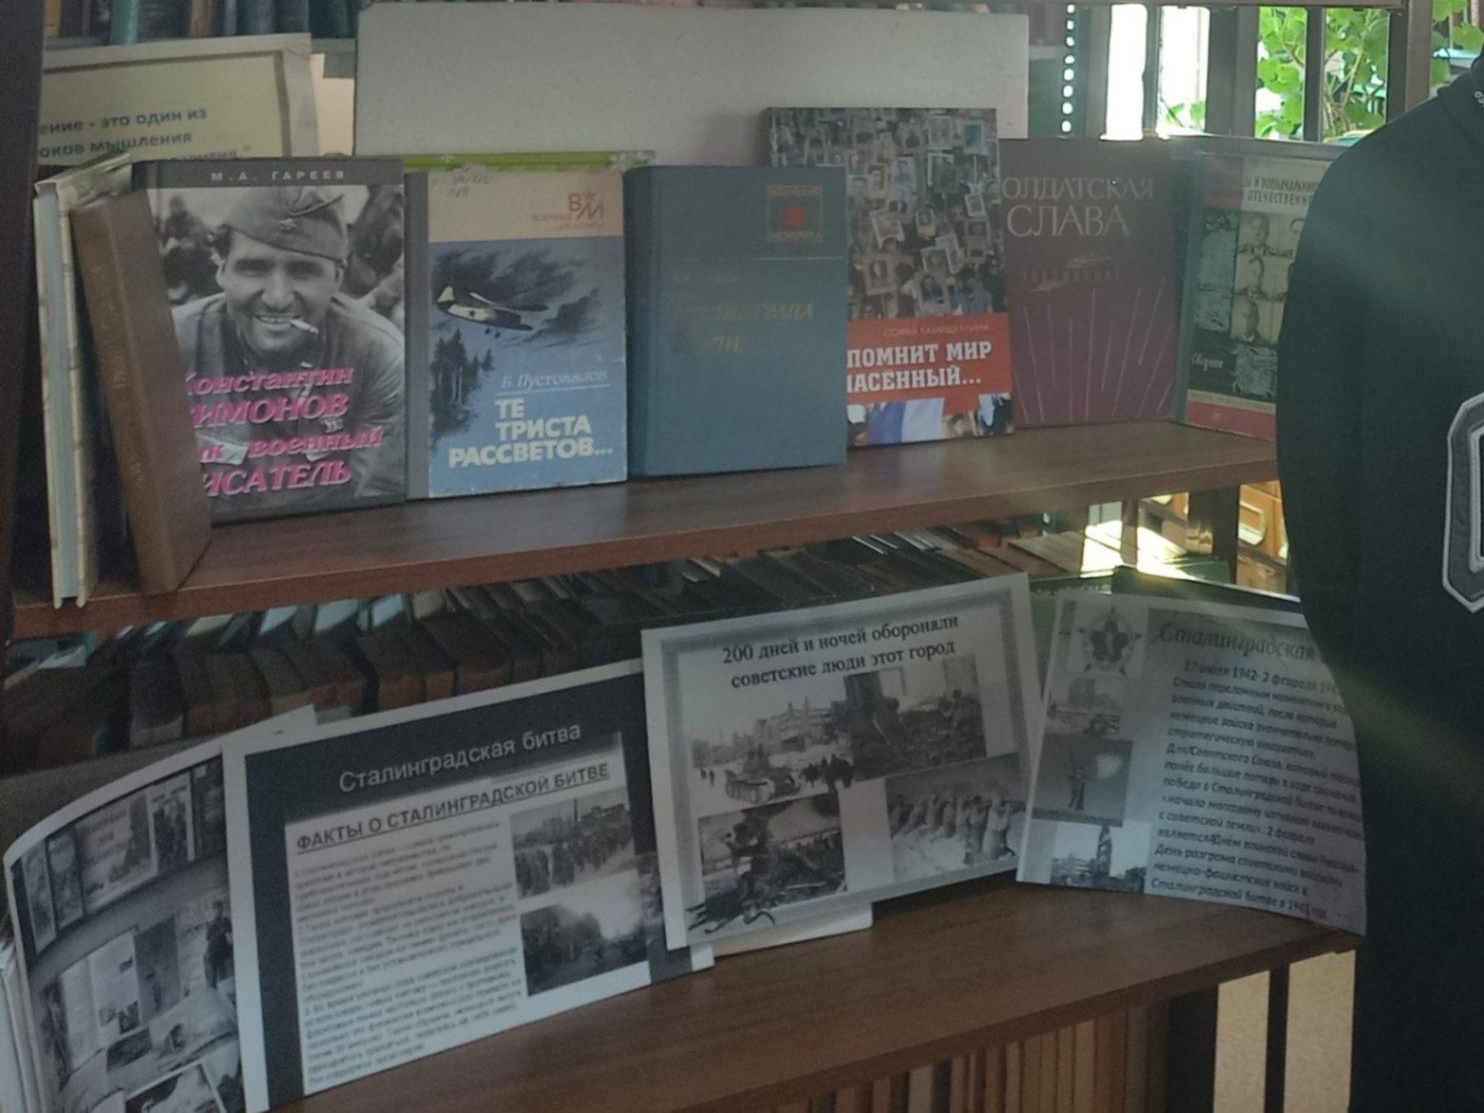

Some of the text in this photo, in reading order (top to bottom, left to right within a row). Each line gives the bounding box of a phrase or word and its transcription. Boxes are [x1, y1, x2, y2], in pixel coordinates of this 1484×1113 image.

[100, 115, 131, 129] это
[135, 112, 184, 127] один
[186, 107, 208, 121] из
[89, 132, 194, 154] мышления
[270, 168, 347, 182] ГАРЕЕВ
[1006, 203, 1131, 238] СЛАВА
[846, 339, 994, 369] ПОМНИТ МИР
[192, 393, 350, 429] ИМОНОВ
[494, 397, 526, 419] ТЕ
[248, 425, 385, 458] военный
[494, 414, 593, 440] ТРИСТА
[448, 438, 614, 469] РАССВЕТОВ...
[721, 613, 960, 665] 200 дней и ночей обороняли
[730, 639, 956, 689] советские люди этот город
[338, 721, 583, 794] Сталинградская битва
[295, 762, 610, 850] ФАКТЫ О СТАЛИНГРАДСКОЙ БИТВЕ
